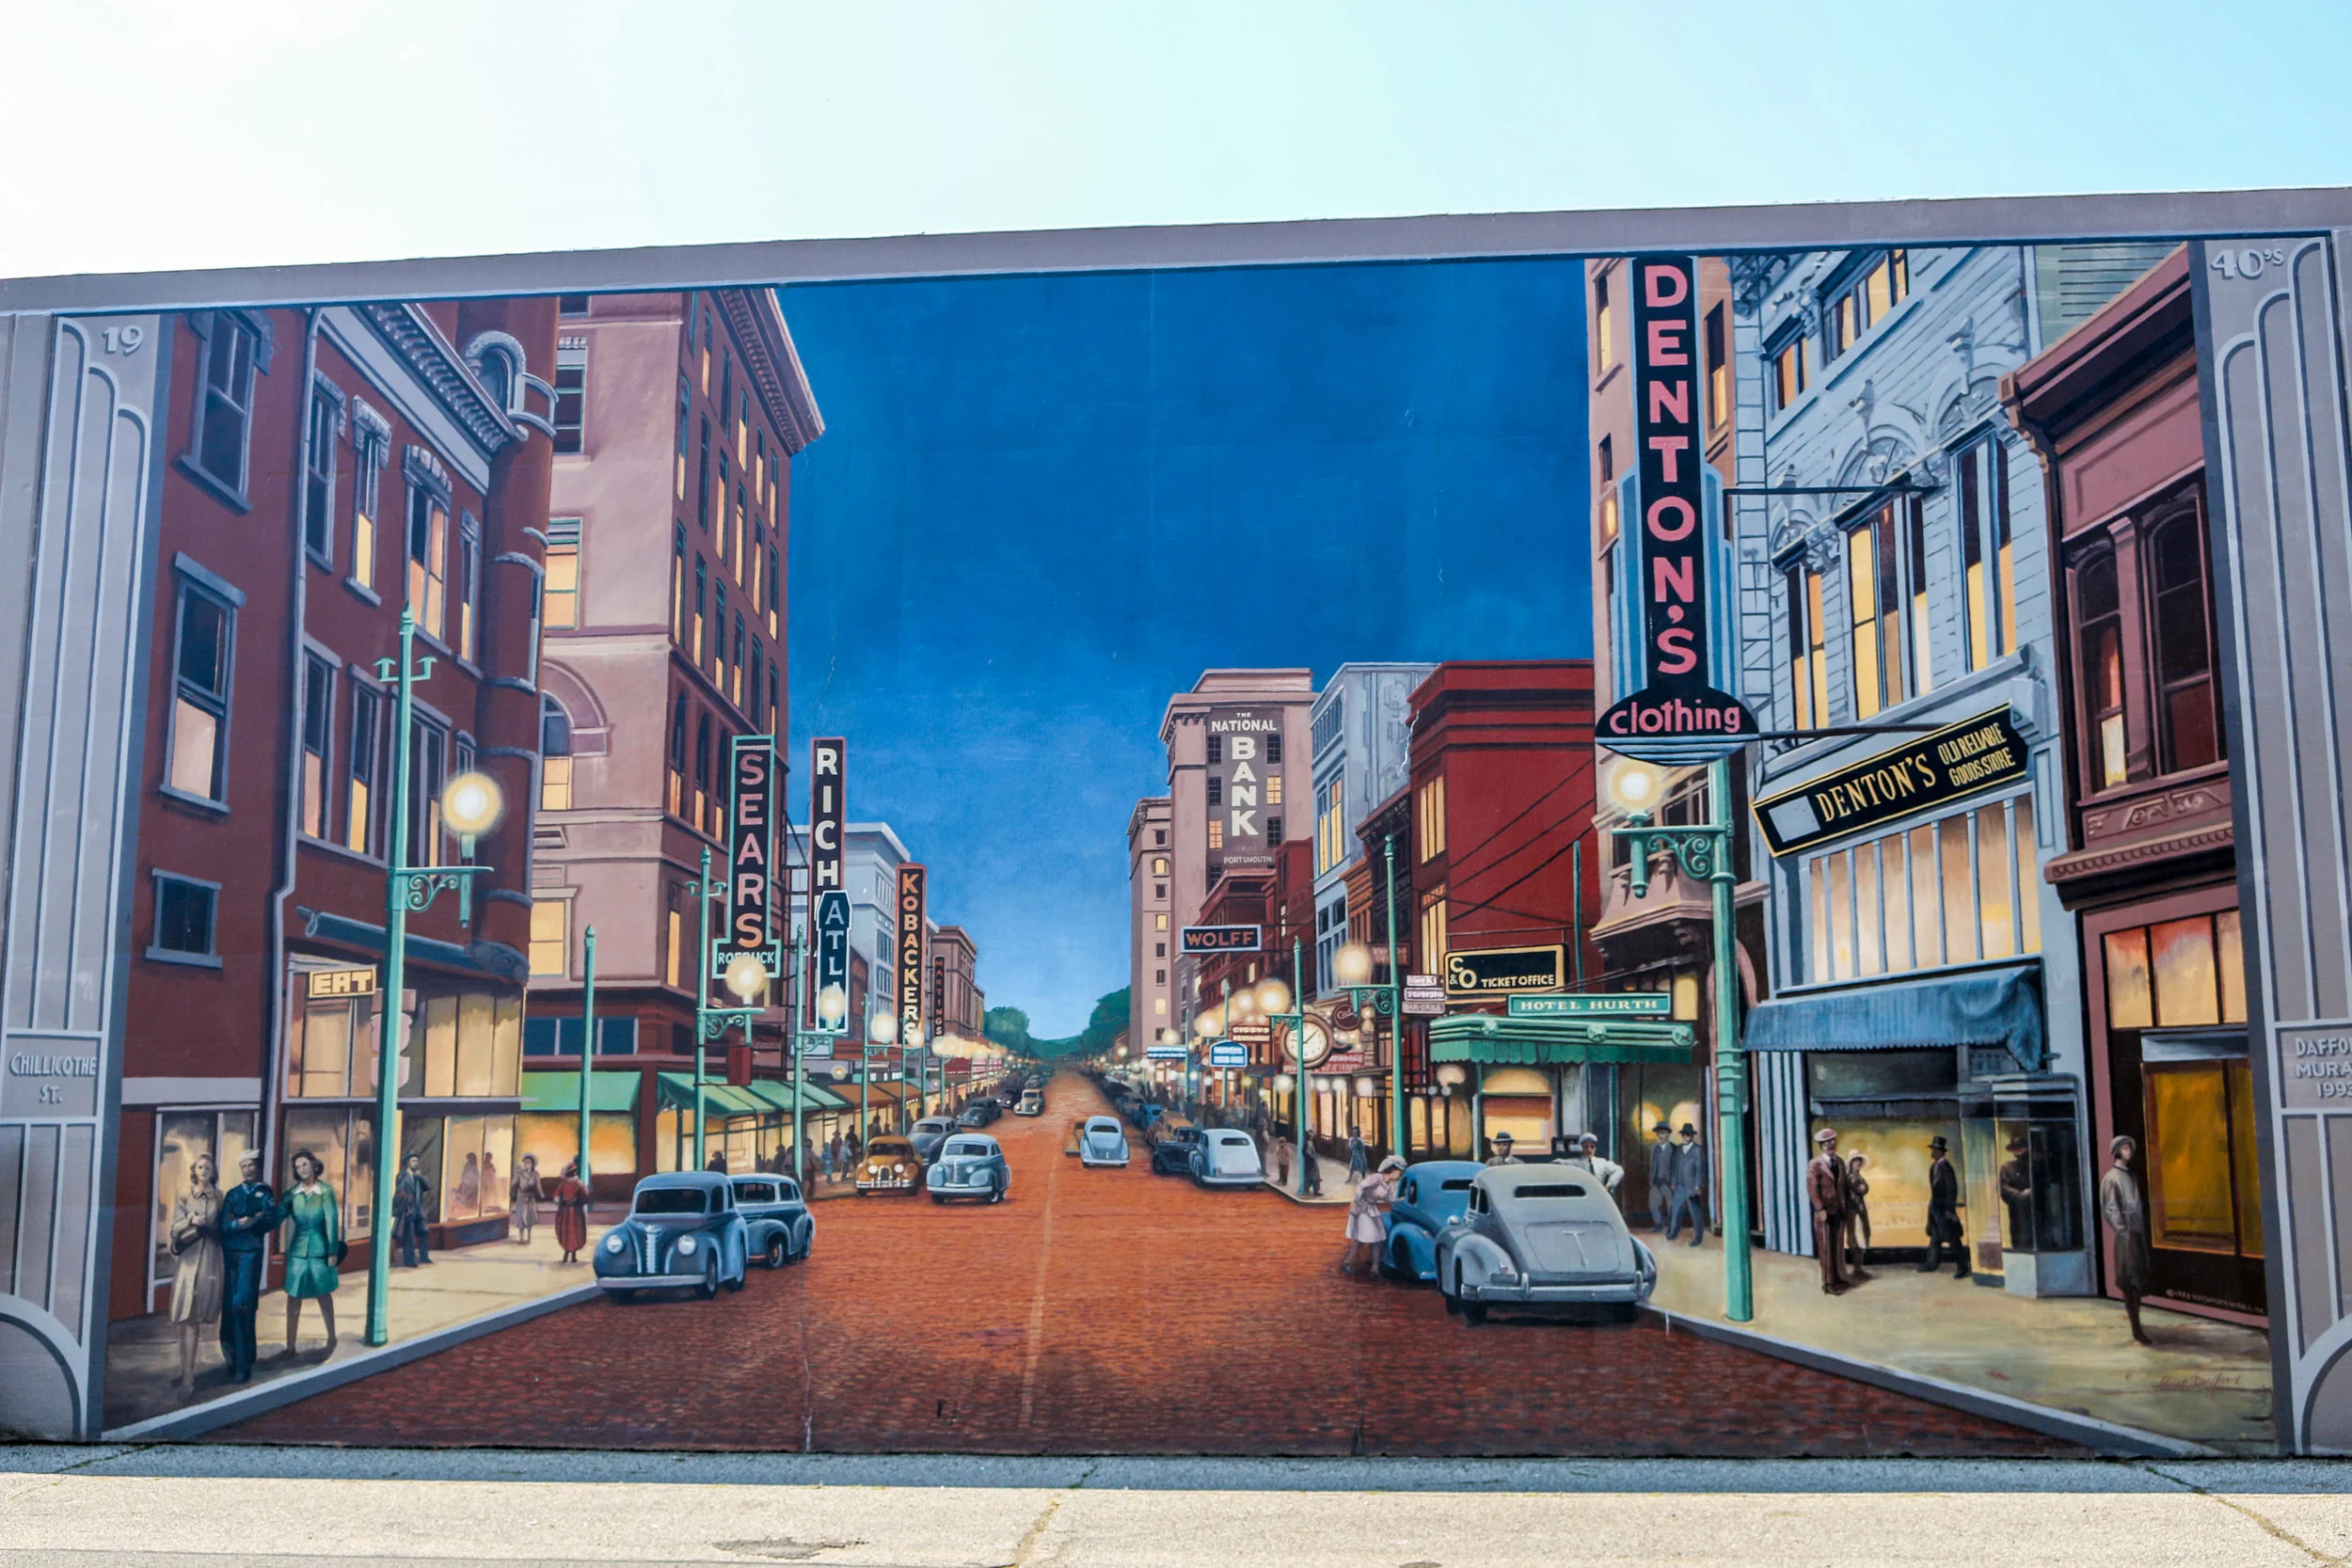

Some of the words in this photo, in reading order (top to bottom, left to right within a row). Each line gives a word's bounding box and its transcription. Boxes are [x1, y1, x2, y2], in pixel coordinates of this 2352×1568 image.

[102, 325, 143, 356] 19
[1645, 264, 1697, 674] DENTON'S
[1211, 720, 1277, 732] NATIONAL
[1610, 699, 1740, 735] clothing
[1938, 737, 1961, 765] OLD
[1959, 722, 2007, 758] RELIABLE
[1948, 757, 1986, 787] GOODS
[1981, 747, 2016, 775] STORE
[1232, 736, 1259, 836] BANK
[1815, 753, 1936, 822] DENTON'S
[737, 753, 765, 948] SEARS
[1223, 855, 1272, 864] PORTSMOUTH
[1185, 931, 1254, 946] WOLFF
[313, 971, 373, 994] EAT
[1481, 976, 1518, 989] TICKET
[1518, 974, 1555, 986] OFFICE
[1520, 1001, 1581, 1010] HOTEL
[1589, 1000, 1658, 1010] HURTH
[9, 1051, 97, 1077] CHILLICOTHE
[40, 1083, 63, 1104] ST.
